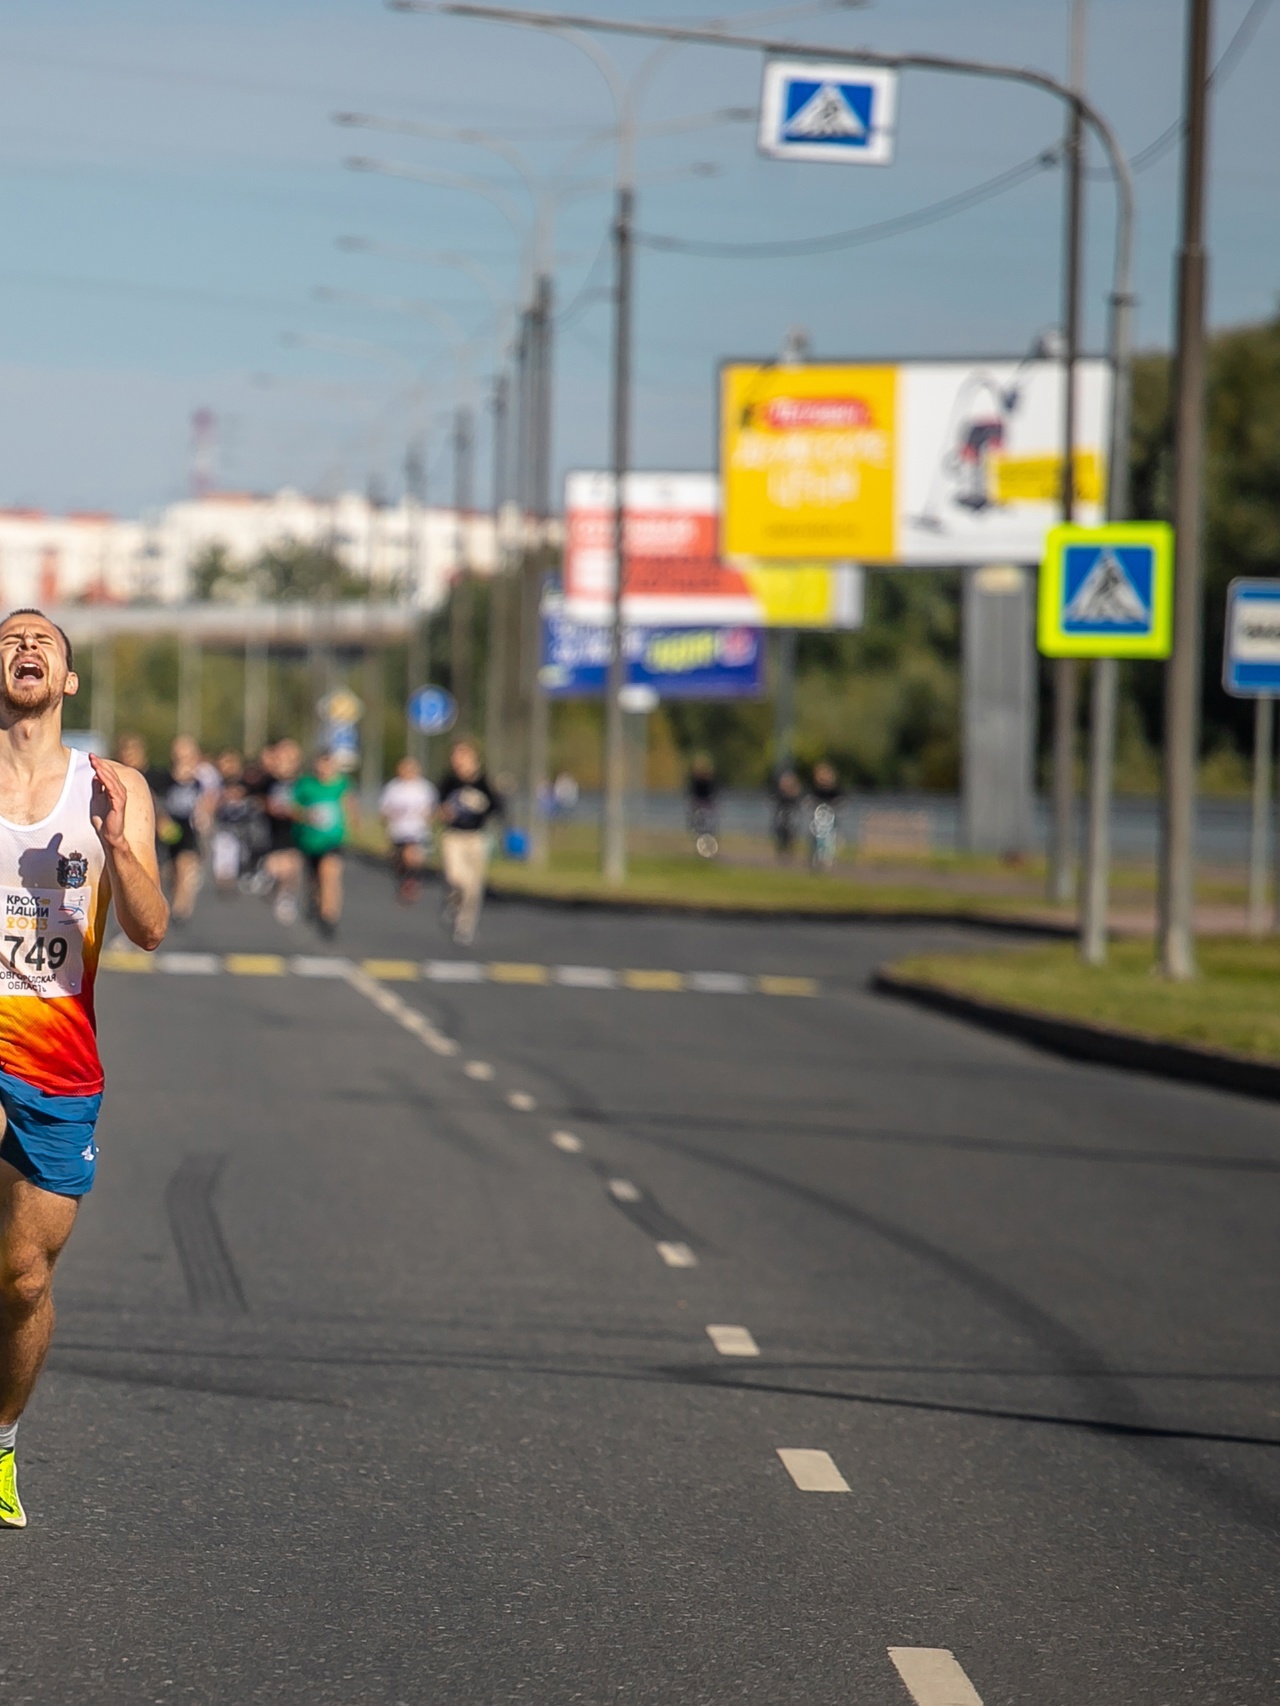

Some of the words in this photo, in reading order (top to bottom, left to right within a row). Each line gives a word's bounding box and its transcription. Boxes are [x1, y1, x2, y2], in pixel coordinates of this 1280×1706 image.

[6, 894, 41, 906] КРОСС
[6, 905, 49, 918] НАЦИИ
[6, 916, 48, 931] 2023
[8, 981, 47, 992] ОБЛАСТЬ
